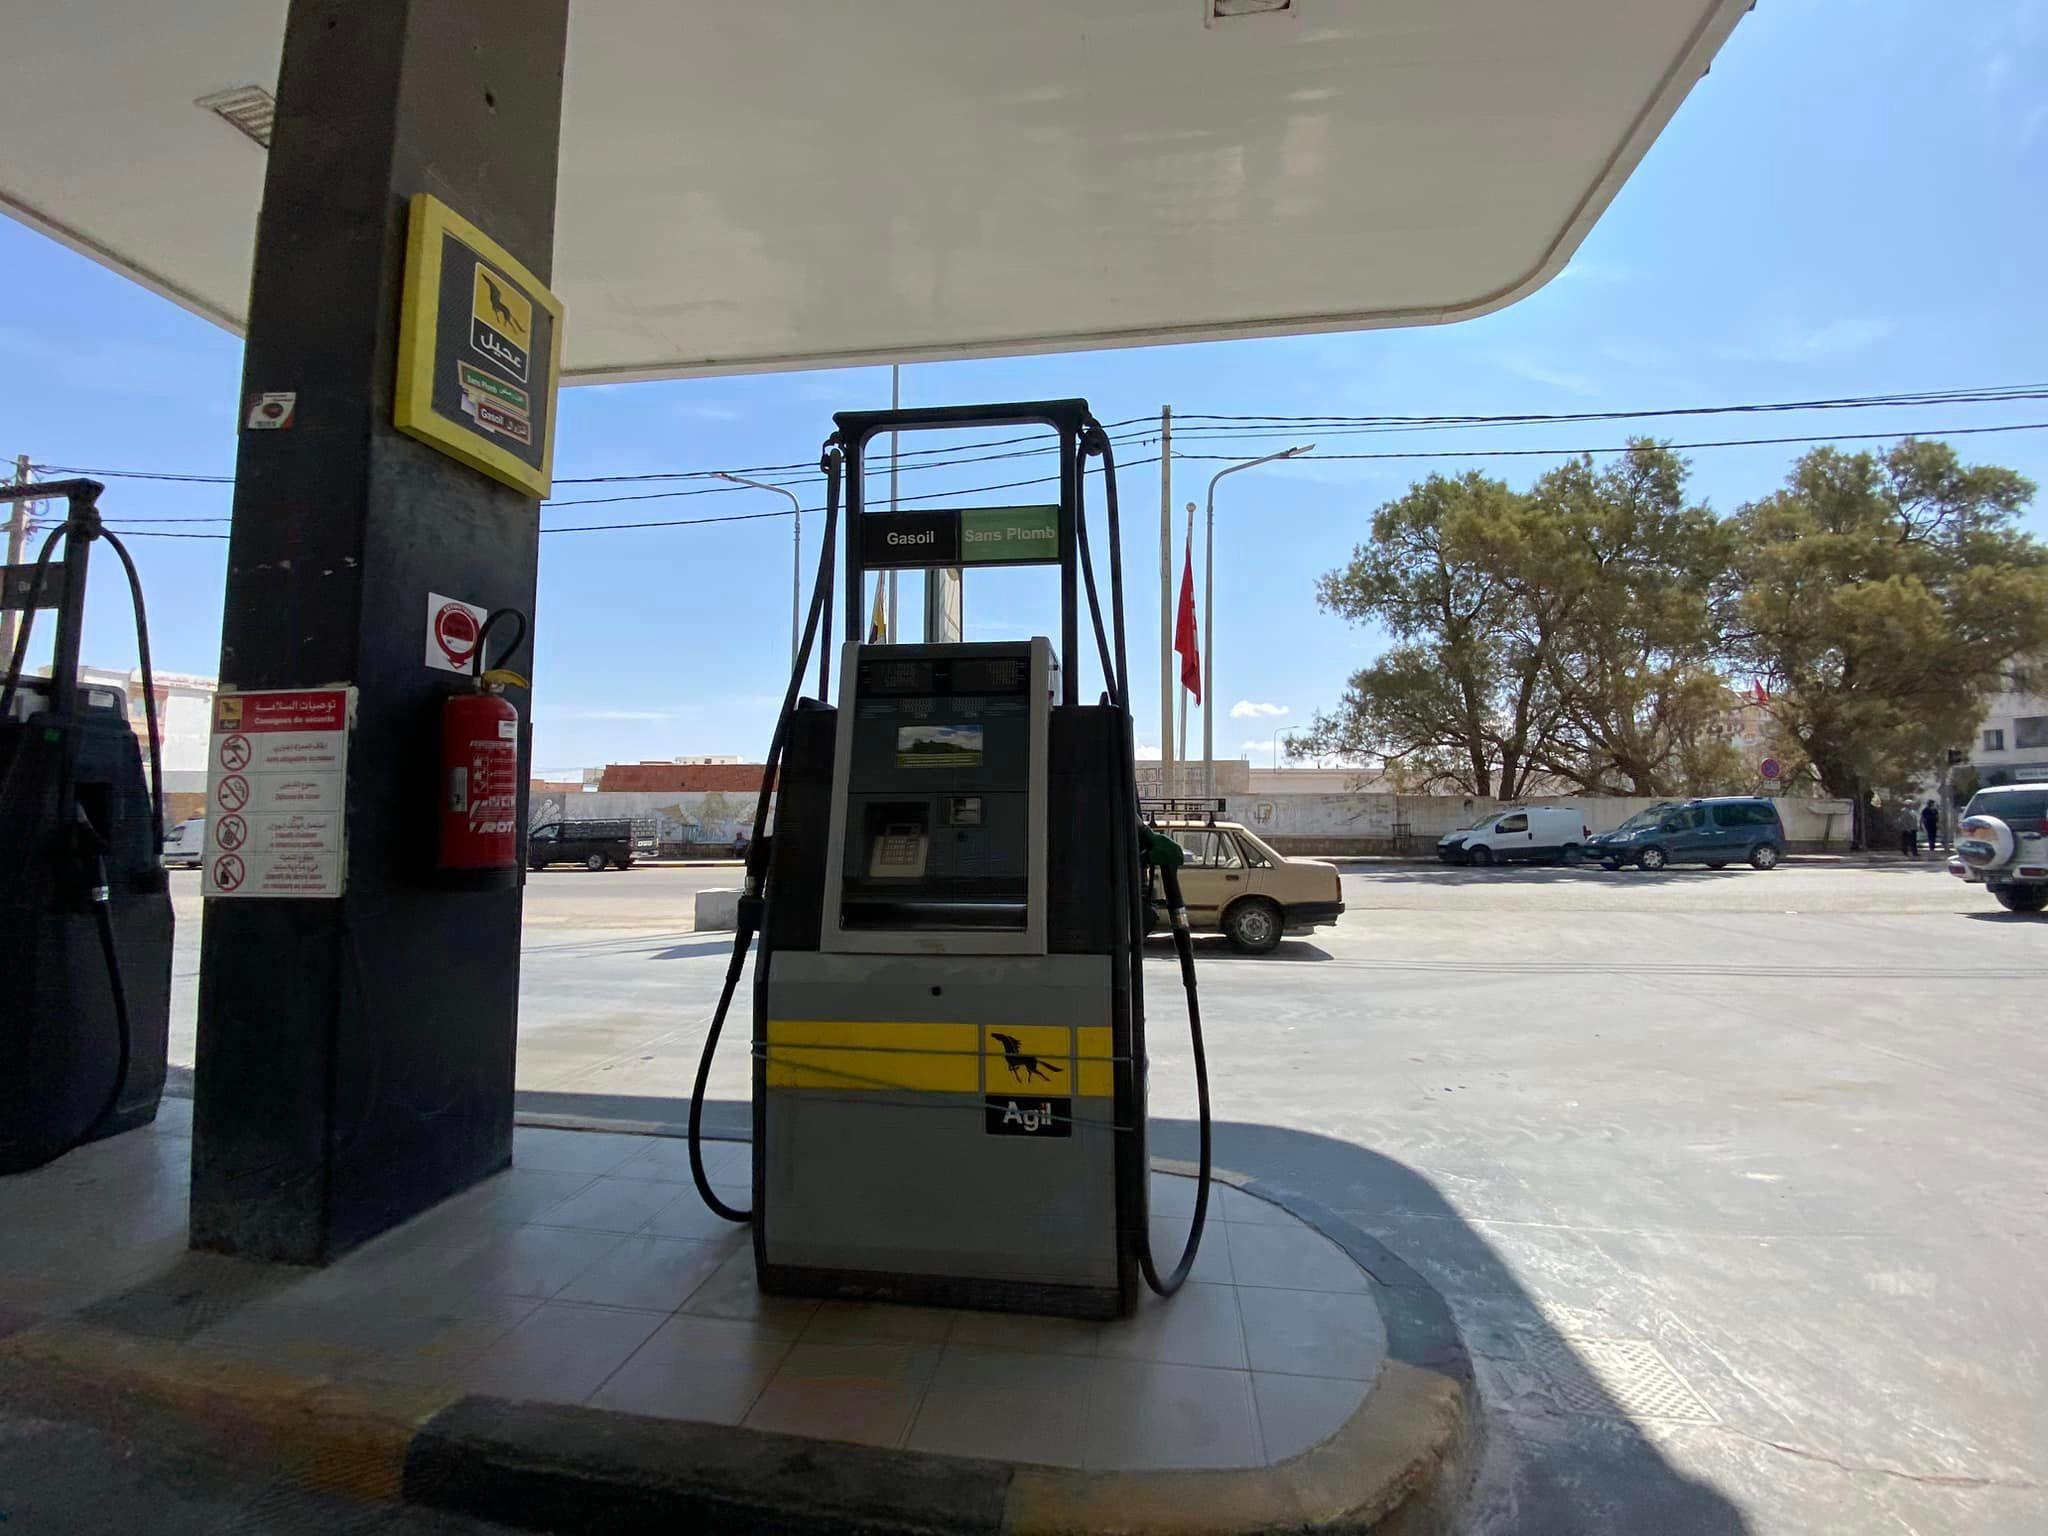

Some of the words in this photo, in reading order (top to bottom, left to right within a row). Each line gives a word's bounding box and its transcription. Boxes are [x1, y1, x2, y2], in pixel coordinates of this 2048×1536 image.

[887, 530, 935, 546] Gasoil
[964, 529, 1001, 543] Sans
[1007, 526, 1056, 541] Plomb
[1003, 1101, 1052, 1132] Agil
